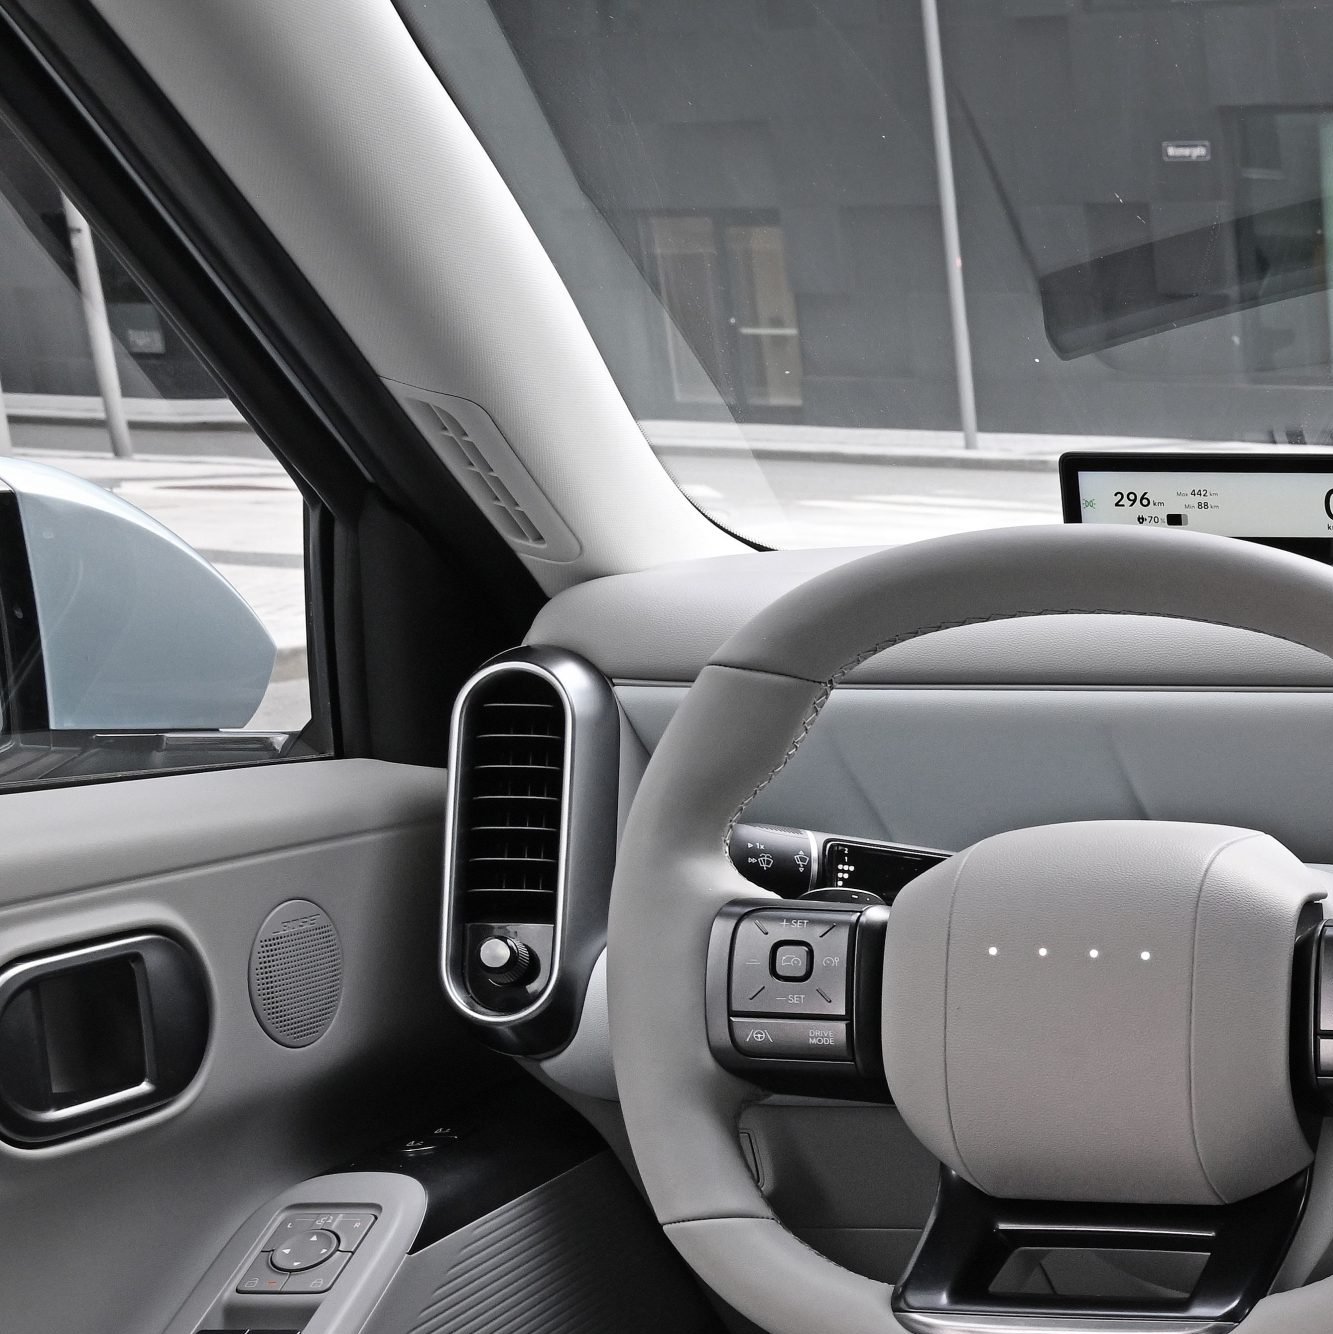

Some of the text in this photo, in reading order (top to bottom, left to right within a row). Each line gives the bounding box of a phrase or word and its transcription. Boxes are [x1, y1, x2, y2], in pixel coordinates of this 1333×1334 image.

[1190, 489, 1208, 497] 442
[1114, 491, 1151, 508] 296
[1197, 502, 1209, 510] 88
[809, 1029, 834, 1037] DRIVE
[809, 1037, 835, 1045] MODE
